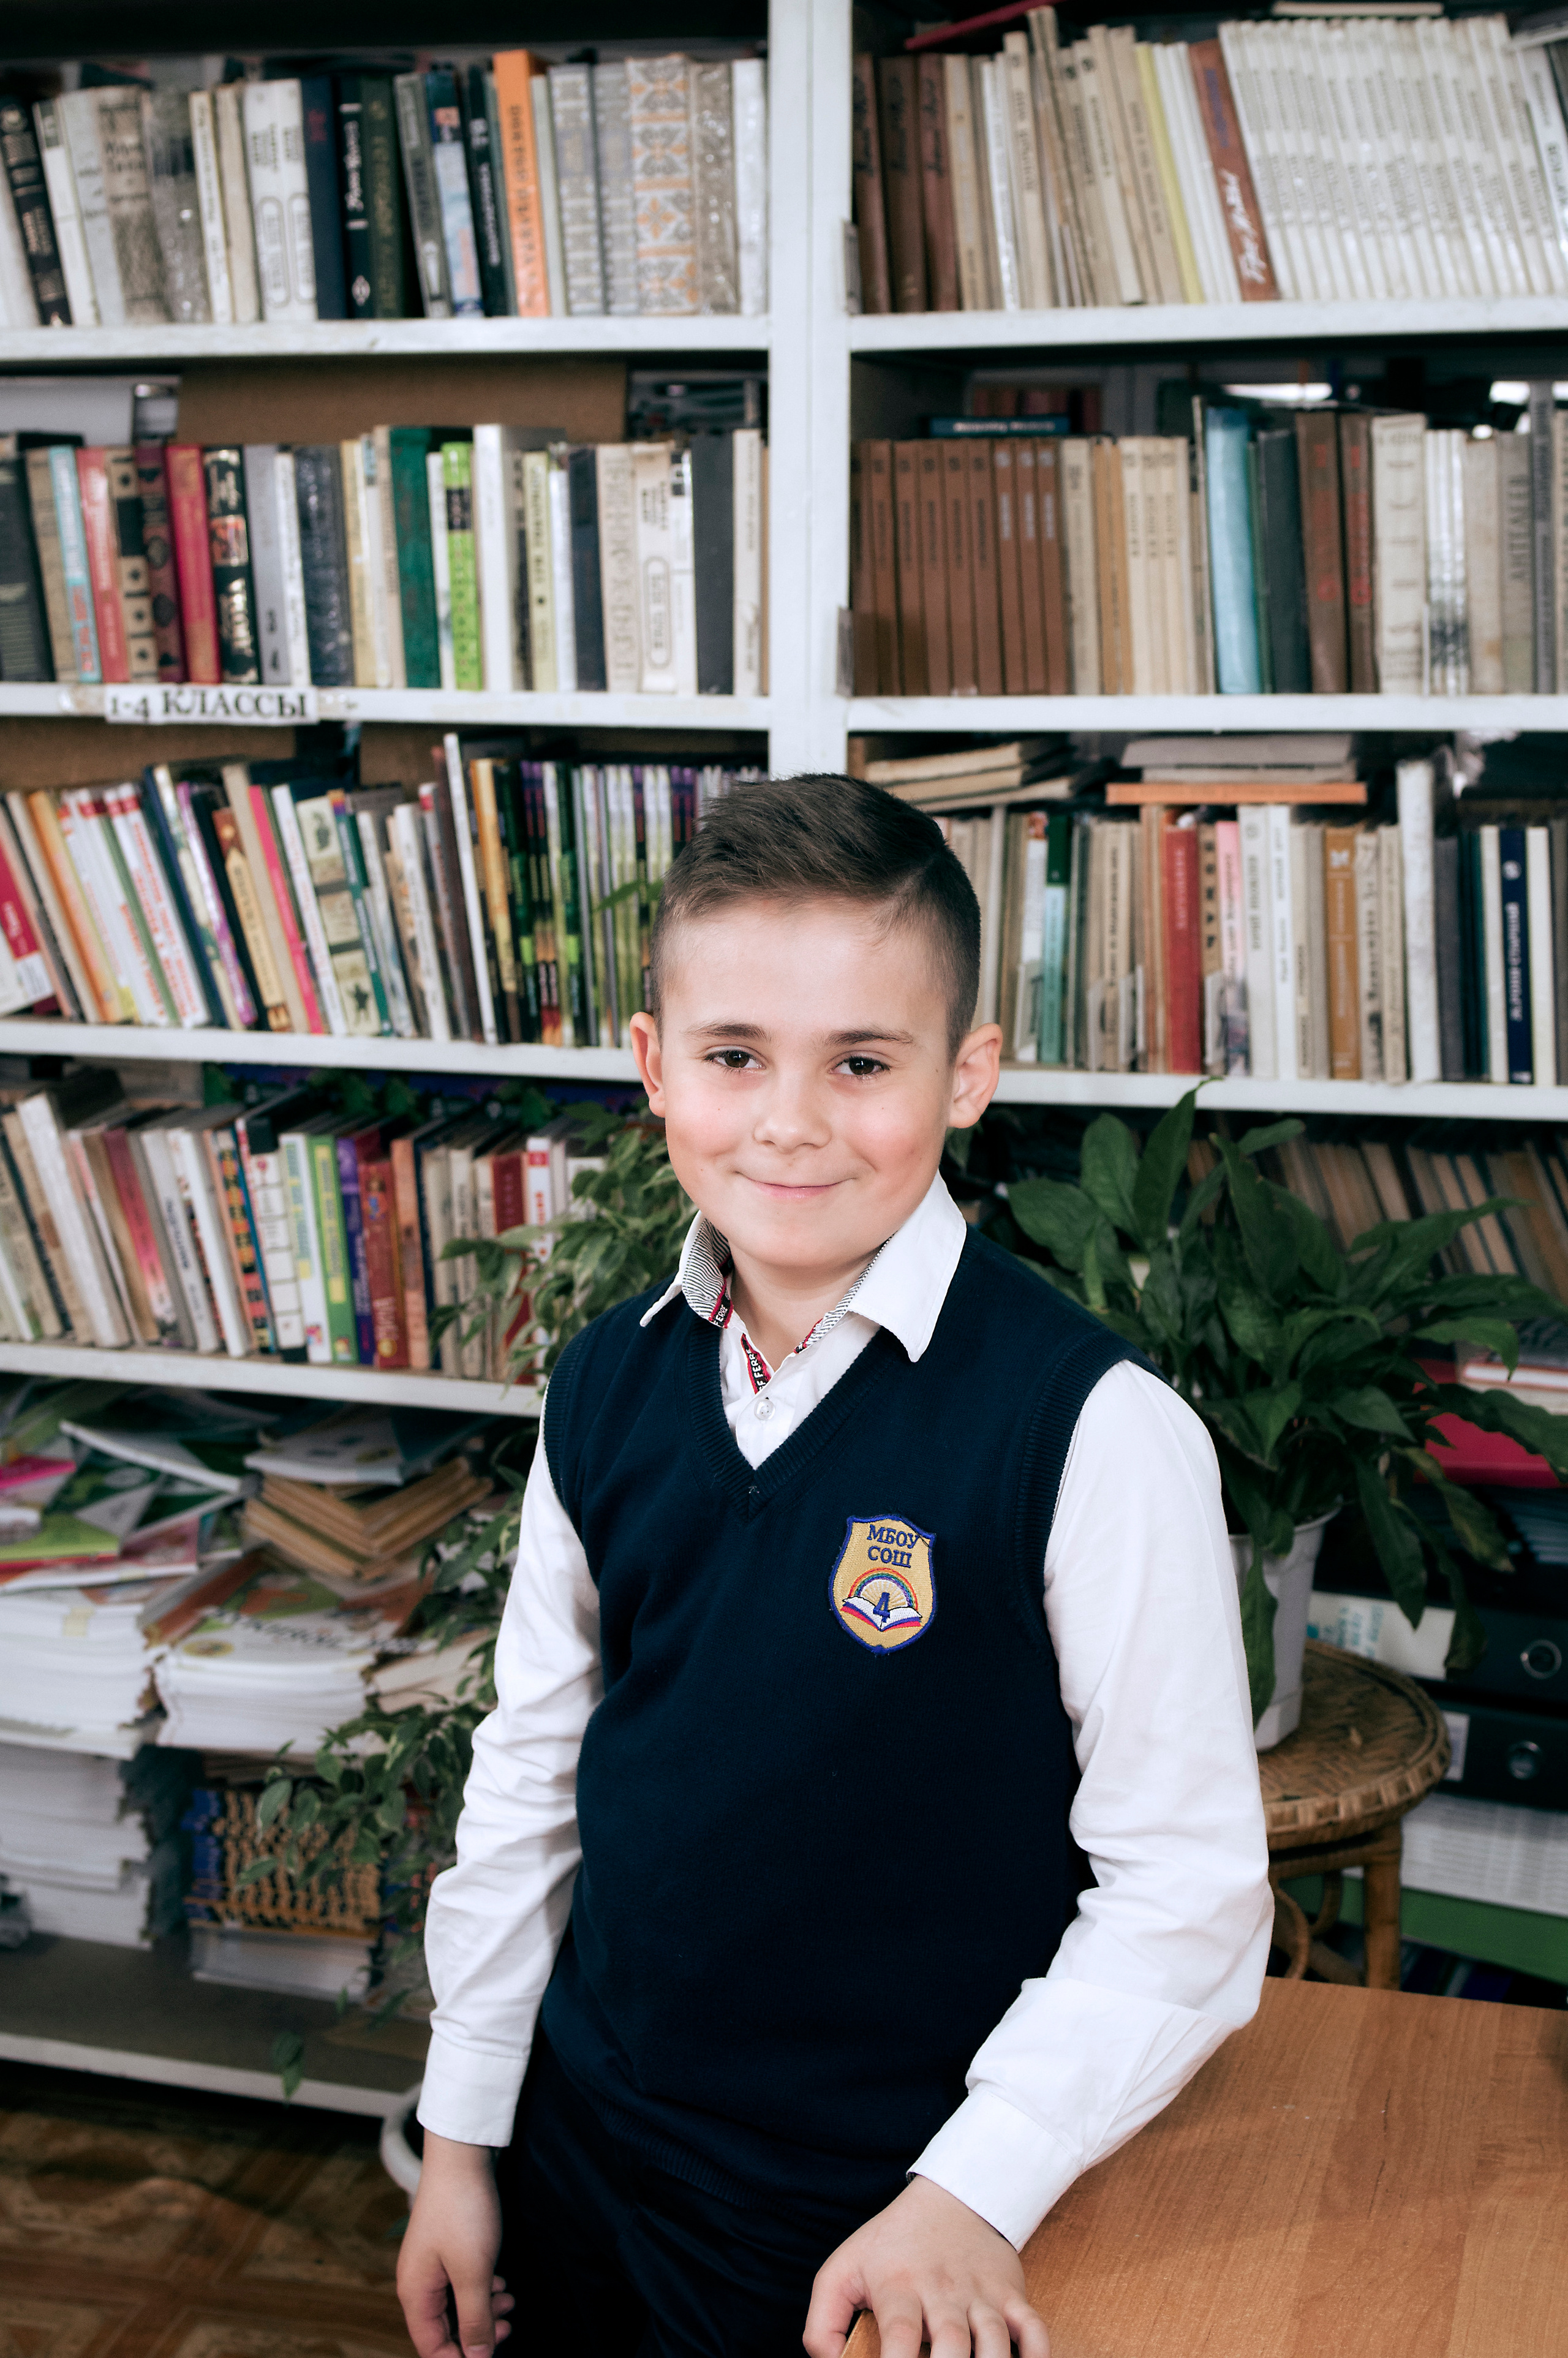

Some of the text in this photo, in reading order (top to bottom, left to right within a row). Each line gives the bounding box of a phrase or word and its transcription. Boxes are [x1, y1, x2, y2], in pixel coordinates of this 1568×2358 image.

[111, 689, 307, 723] 1-4 КЛАССЫ
[867, 1524, 919, 1549] МБОУ
[868, 1546, 912, 1568] СОШ
[873, 1592, 891, 1623] 4
